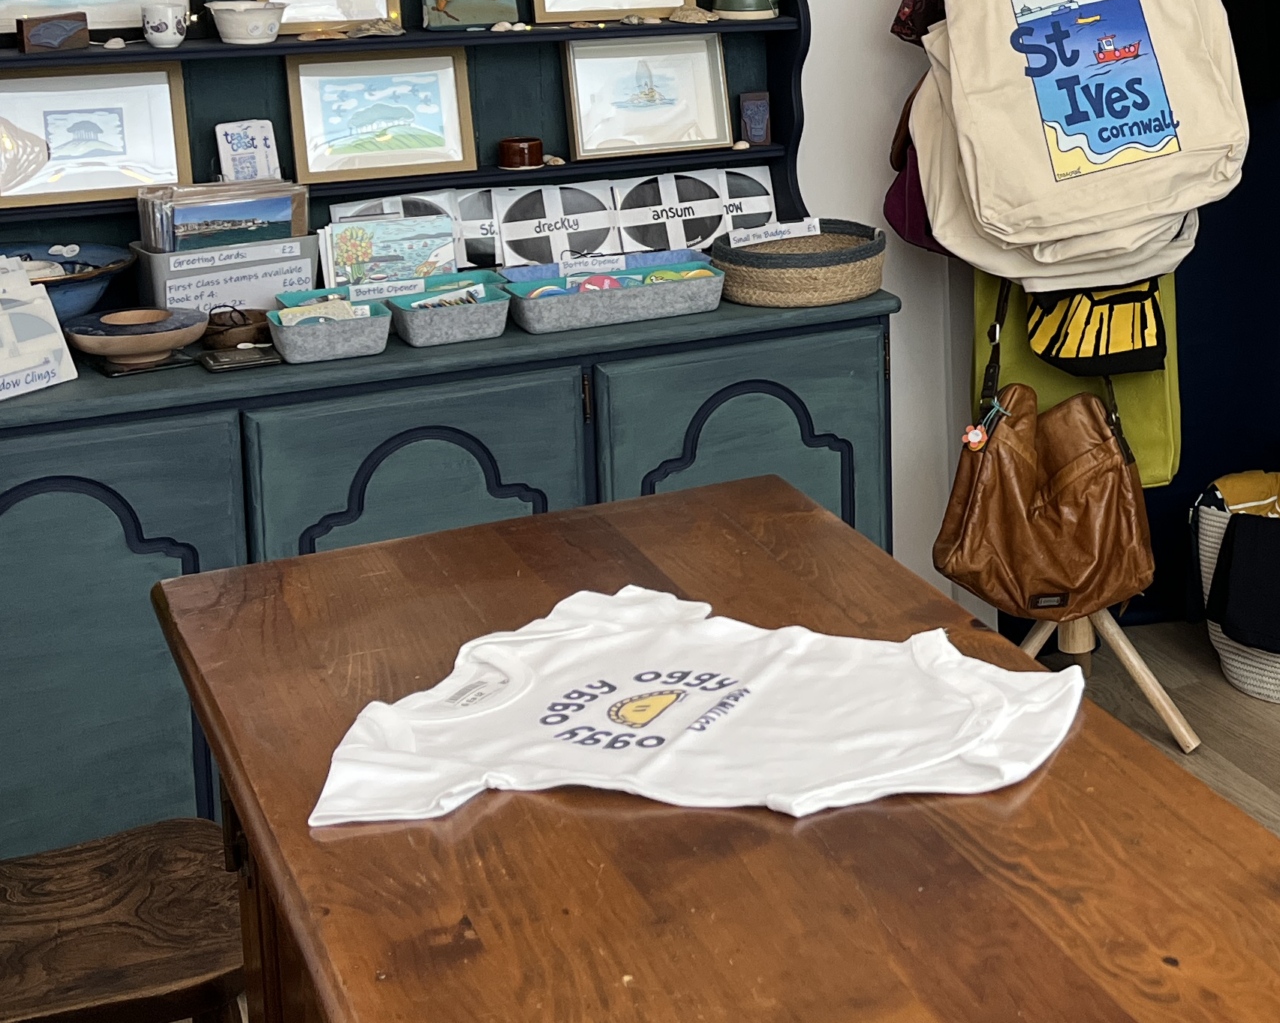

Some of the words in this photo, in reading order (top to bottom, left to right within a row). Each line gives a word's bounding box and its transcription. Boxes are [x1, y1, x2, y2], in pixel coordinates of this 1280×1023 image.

[1009, 20, 1080, 77] St
[1055, 74, 1151, 127] Ives
[1097, 109, 1180, 144] cornwall
[231, 136, 258, 152] coast
[534, 216, 579, 234] dreckly
[733, 236, 750, 245] Small
[764, 228, 792, 240] Badges
[807, 224, 817, 232] £1
[173, 255, 216, 269] Greeting
[218, 251, 247, 264] Cards:
[281, 245, 295, 254] £2
[563, 260, 589, 269] Bottle
[591, 257, 620, 267] Opener
[168, 281, 193, 293] First
[195, 276, 221, 289] Class
[223, 272, 259, 285] stamps
[261, 265, 303, 279] available
[168, 295, 191, 305] Book
[194, 290, 205, 301] of
[282, 277, 311, 288] £6.80
[355, 287, 384, 297] Bottle
[387, 283, 418, 294] Opener
[24, 368, 57, 385] Clings
[633, 670, 739, 691] oggy
[539, 679, 617, 726] oggy
[553, 725, 666, 750] oggy
